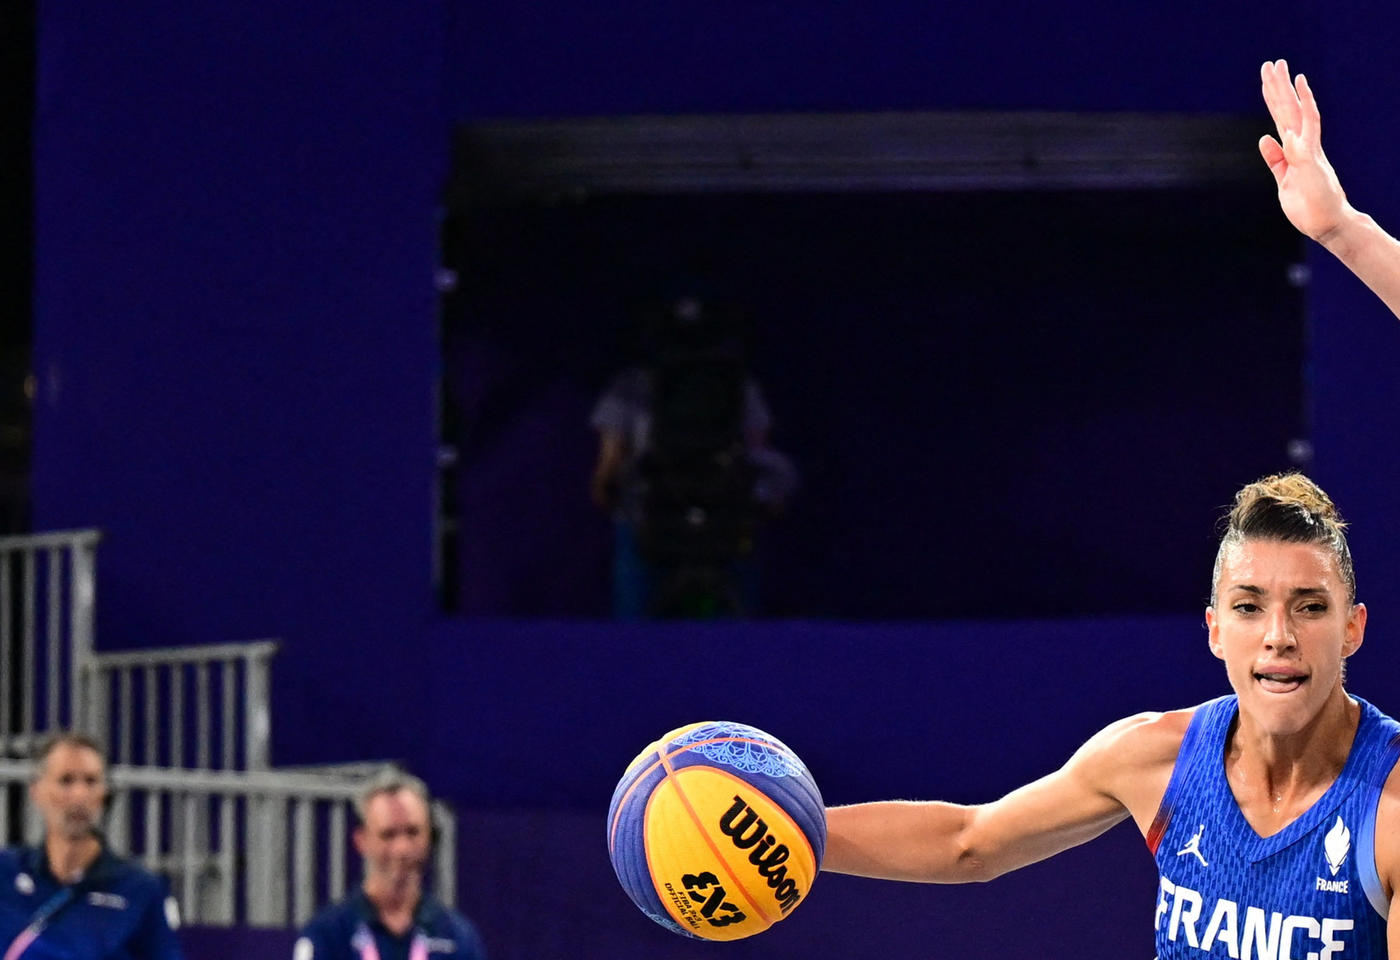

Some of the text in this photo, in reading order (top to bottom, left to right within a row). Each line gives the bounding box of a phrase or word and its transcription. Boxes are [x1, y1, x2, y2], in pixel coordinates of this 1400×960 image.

[719, 795, 801, 914] Wilson
[664, 882, 688, 915] OFFICIAL
[1315, 875, 1349, 894] FRANCE
